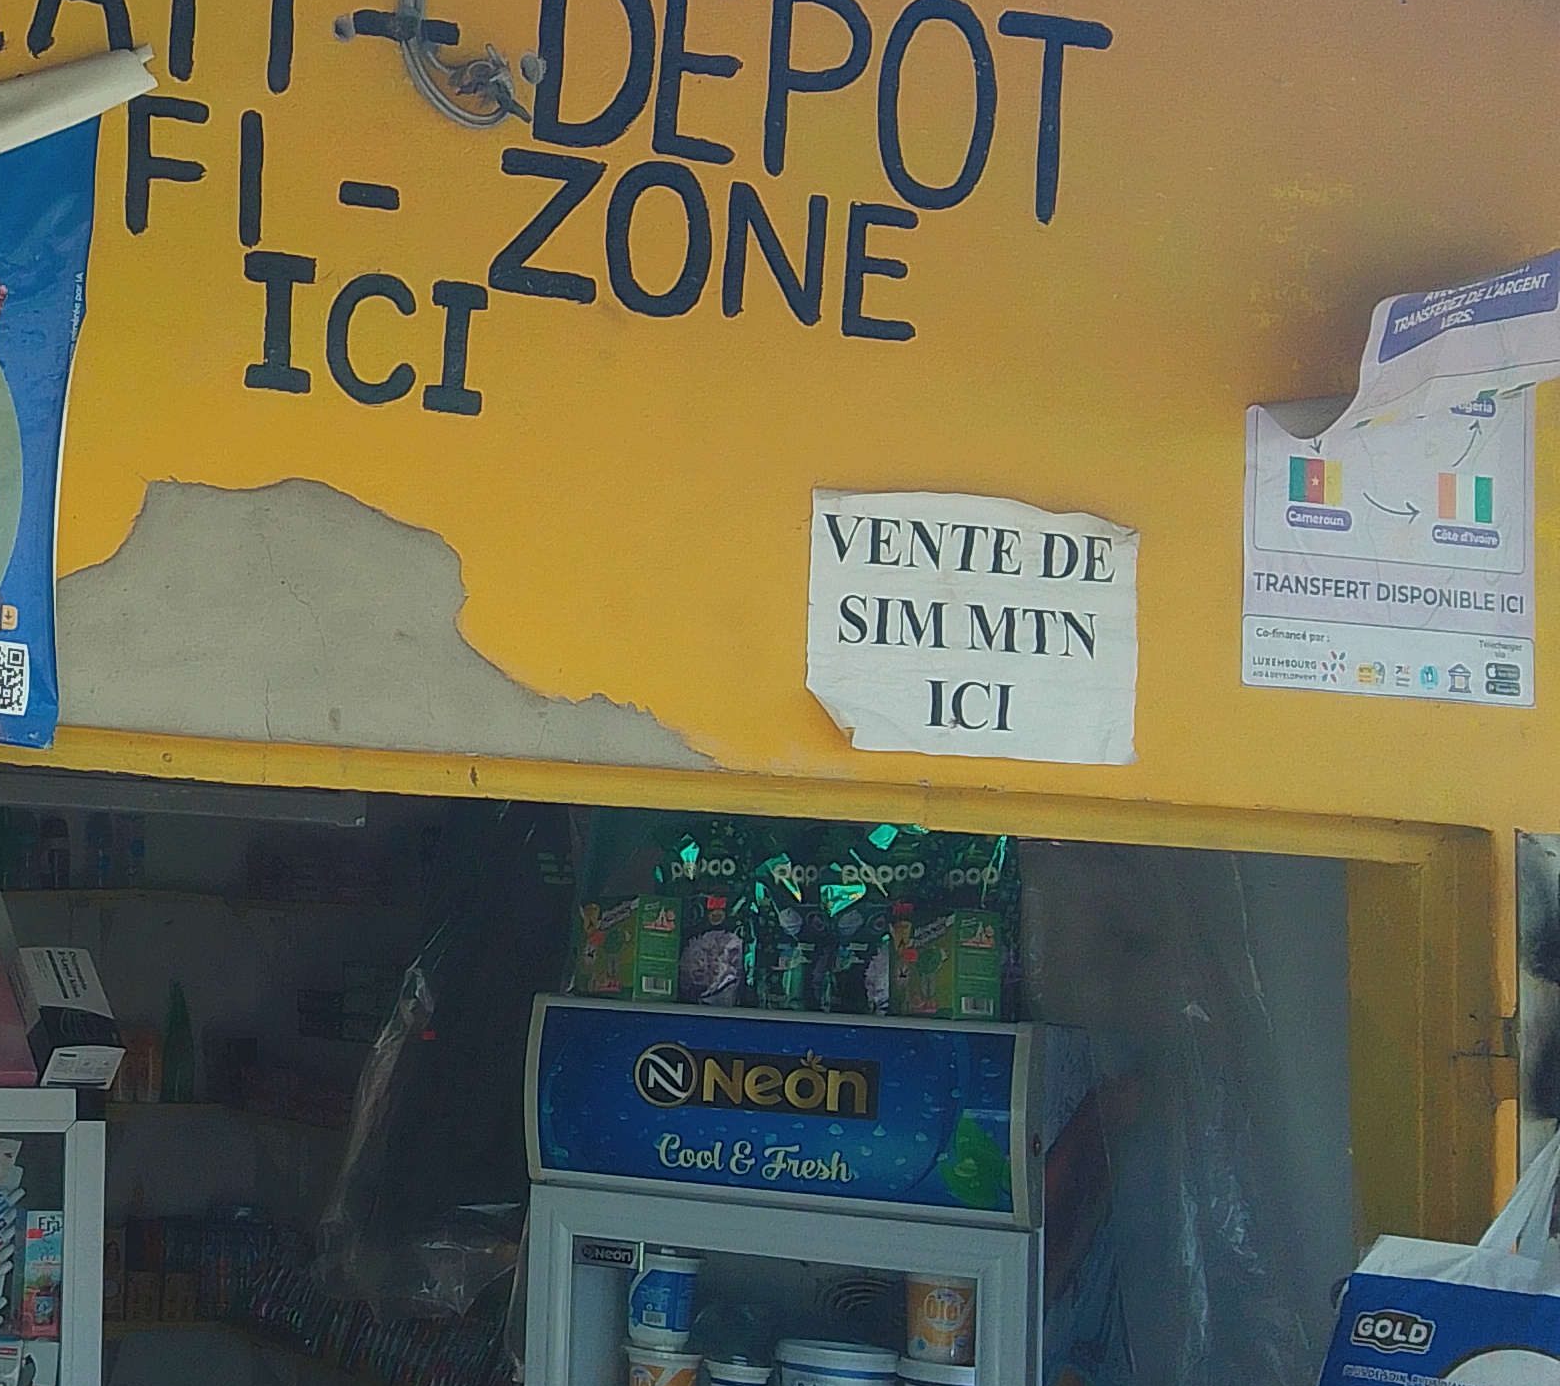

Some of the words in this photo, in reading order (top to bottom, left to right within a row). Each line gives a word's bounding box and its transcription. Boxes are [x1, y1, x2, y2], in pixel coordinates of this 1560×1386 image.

[127, 94, 264, 249] FI
[488, 148, 918, 341] ZONE
[1464, 290, 1484, 306] DE
[1484, 272, 1551, 301] L'ARGENT
[243, 250, 488, 416] ICI
[1289, 511, 1344, 526] Cameroun
[1434, 528, 1458, 544] Côte
[823, 513, 1023, 577] VENTE
[1038, 531, 1117, 584] DE
[1253, 571, 1371, 601] TRANSFERT
[1376, 583, 1495, 612] DISPONIBLE
[1500, 594, 1524, 614] ICI
[837, 593, 948, 649] SIM
[967, 603, 1098, 661] MTN
[1252, 655, 1318, 671] LUXEMBOURG
[925, 679, 1014, 732] ICI
[702, 1058, 868, 1115] Neon
[658, 1134, 724, 1171] Cool
[729, 1140, 756, 1175] &
[761, 1145, 853, 1183] Fresh
[594, 1245, 632, 1263] Neon
[1357, 1317, 1428, 1344] GOLD
